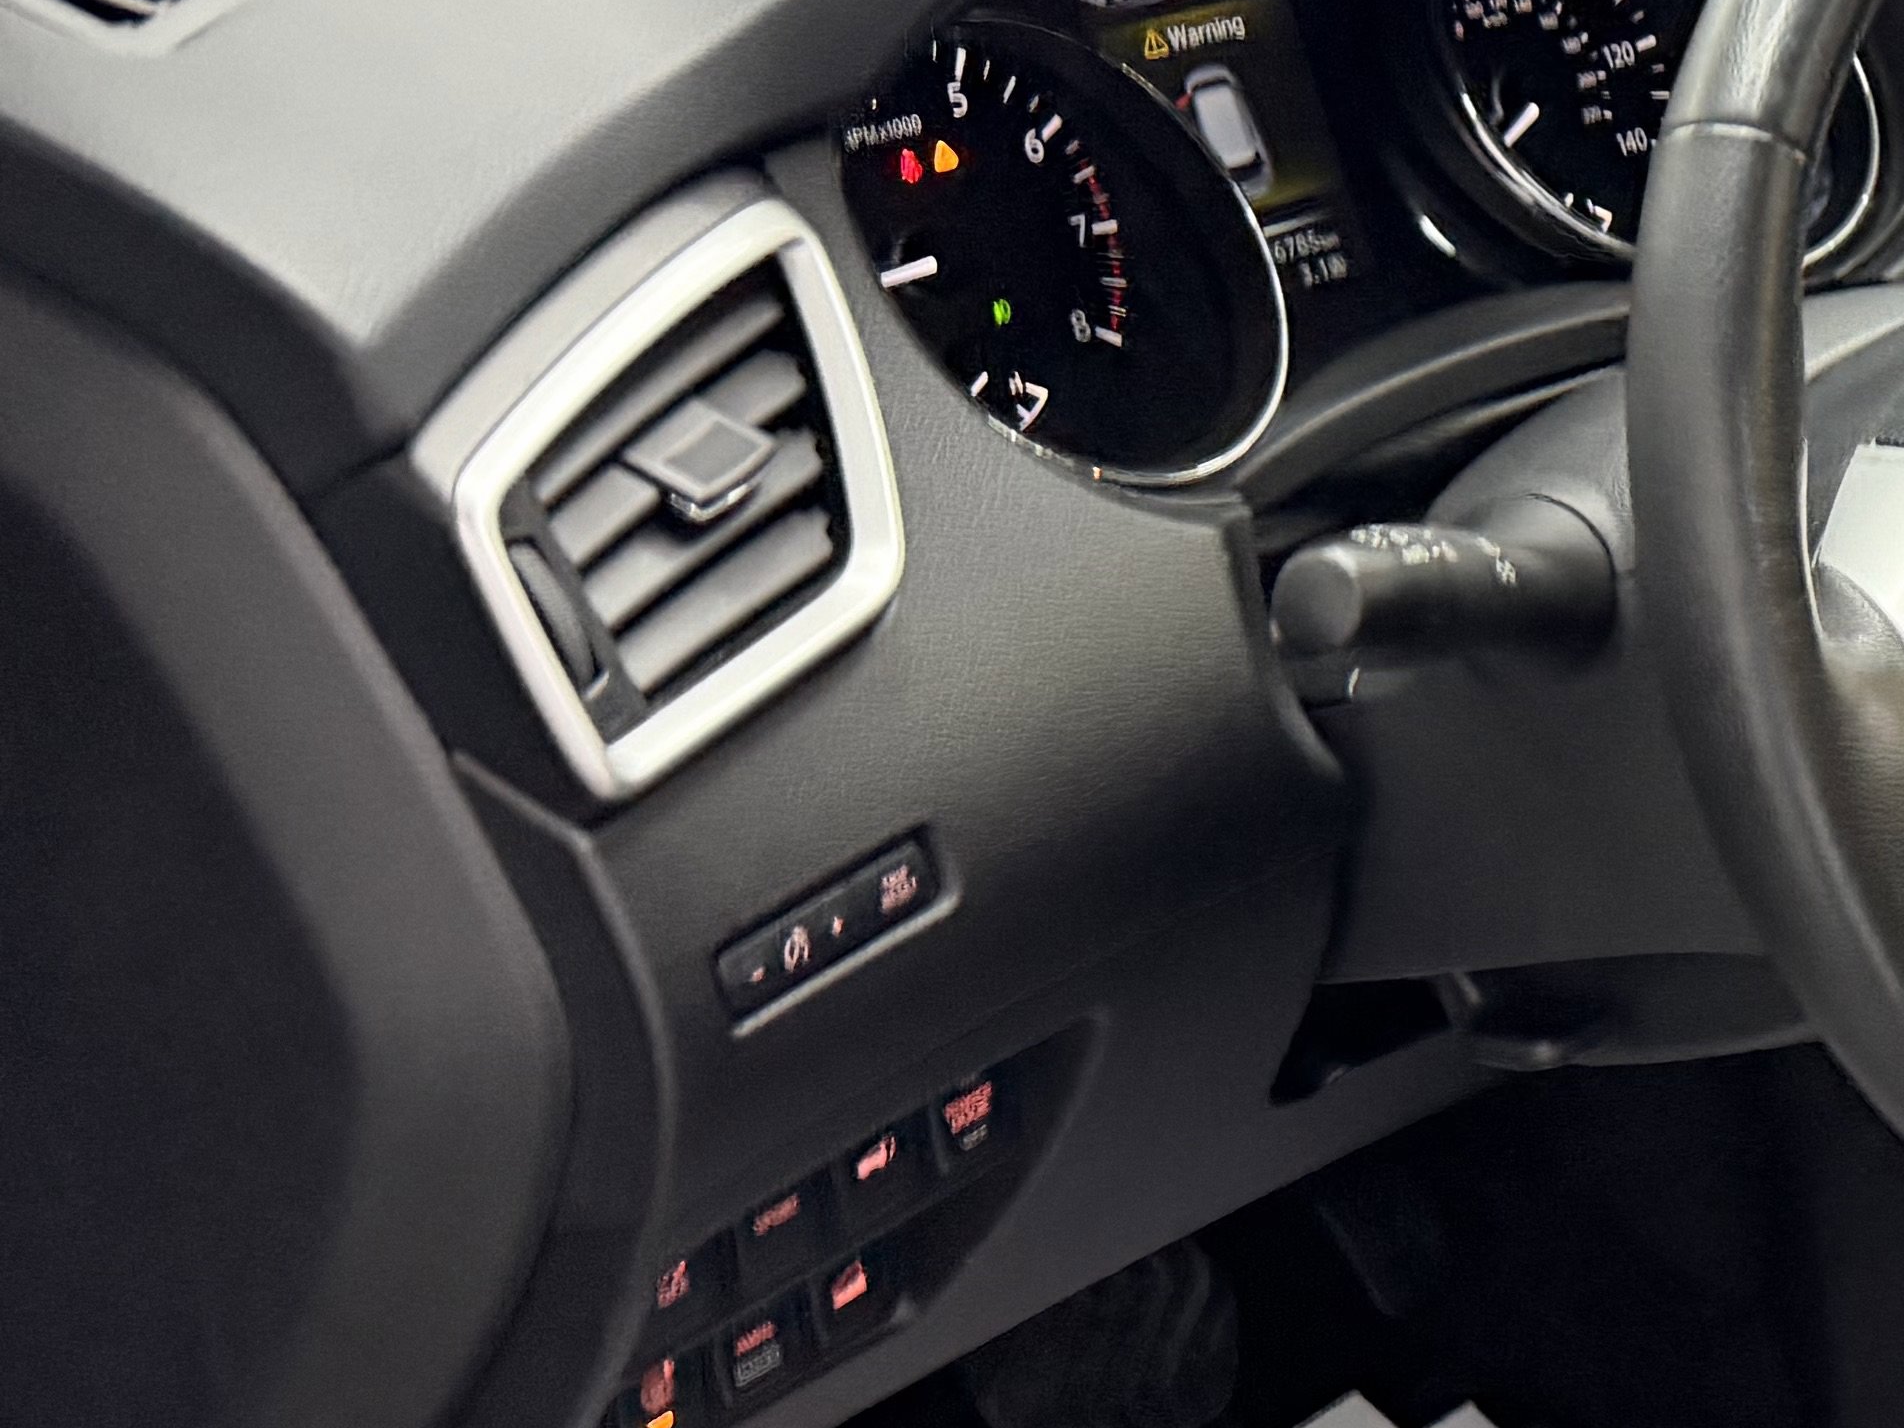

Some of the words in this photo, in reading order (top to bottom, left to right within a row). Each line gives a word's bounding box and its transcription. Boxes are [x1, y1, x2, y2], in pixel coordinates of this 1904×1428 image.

[1167, 15, 1246, 52] Warning
[1603, 41, 1636, 70] 120
[947, 81, 969, 118] 5
[1024, 128, 1045, 163] 6
[1616, 127, 1648, 156] 140
[1069, 213, 1086, 248] 7
[1071, 309, 1091, 343] 8
